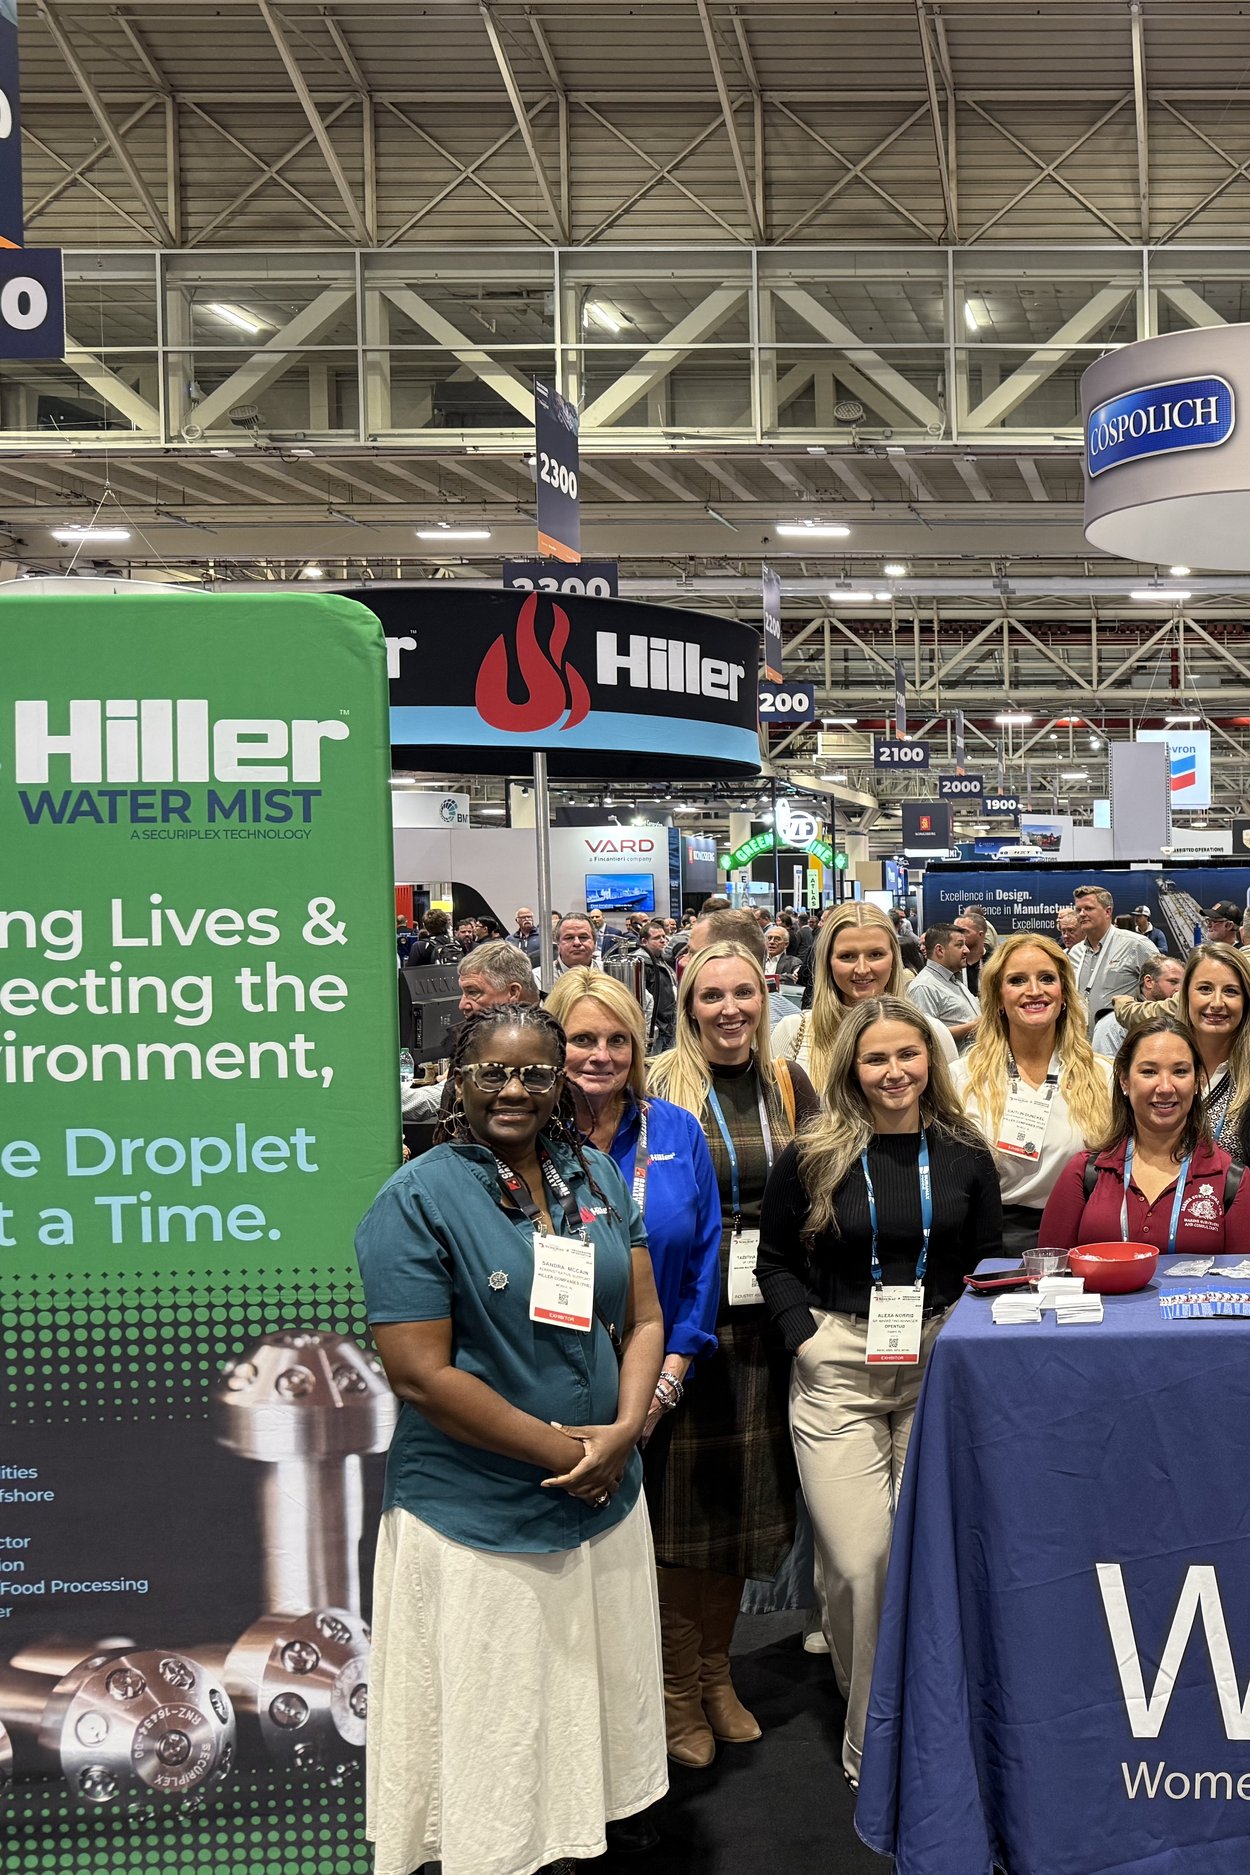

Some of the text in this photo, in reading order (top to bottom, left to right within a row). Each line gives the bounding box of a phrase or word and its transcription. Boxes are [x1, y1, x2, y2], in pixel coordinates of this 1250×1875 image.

[1090, 396, 1219, 456] COSPOLICH
[540, 451, 578, 500] 2300
[765, 611, 780, 639] 2200
[596, 631, 745, 702] Hiller
[15, 699, 350, 784] Hiller
[879, 747, 924, 762] 2100
[942, 780, 981, 793] 2000
[18, 789, 322, 825] WATER MIST
[985, 799, 1017, 810] 1900
[130, 828, 312, 840] A SECURIPLEX TECHNOLOGY
[584, 839, 655, 853] VARD
[940, 888, 1032, 901] Excellence in Design.
[1004, 905, 1011, 915] in
[111, 893, 281, 947] Lives
[302, 896, 348, 946] &
[1012, 917, 1055, 930] Excellence
[235, 961, 348, 1012] the
[66, 1123, 319, 1187] Droplet
[546, 1159, 571, 1197] CARDINAL
[38, 1208, 74, 1245] a
[94, 1190, 281, 1243] Time.
[542, 1260, 589, 1276] SANDRA MCCAIN
[1, 1577, 149, 1595] Food Processing
[154, 1743, 212, 1786] SECURIPLEX
